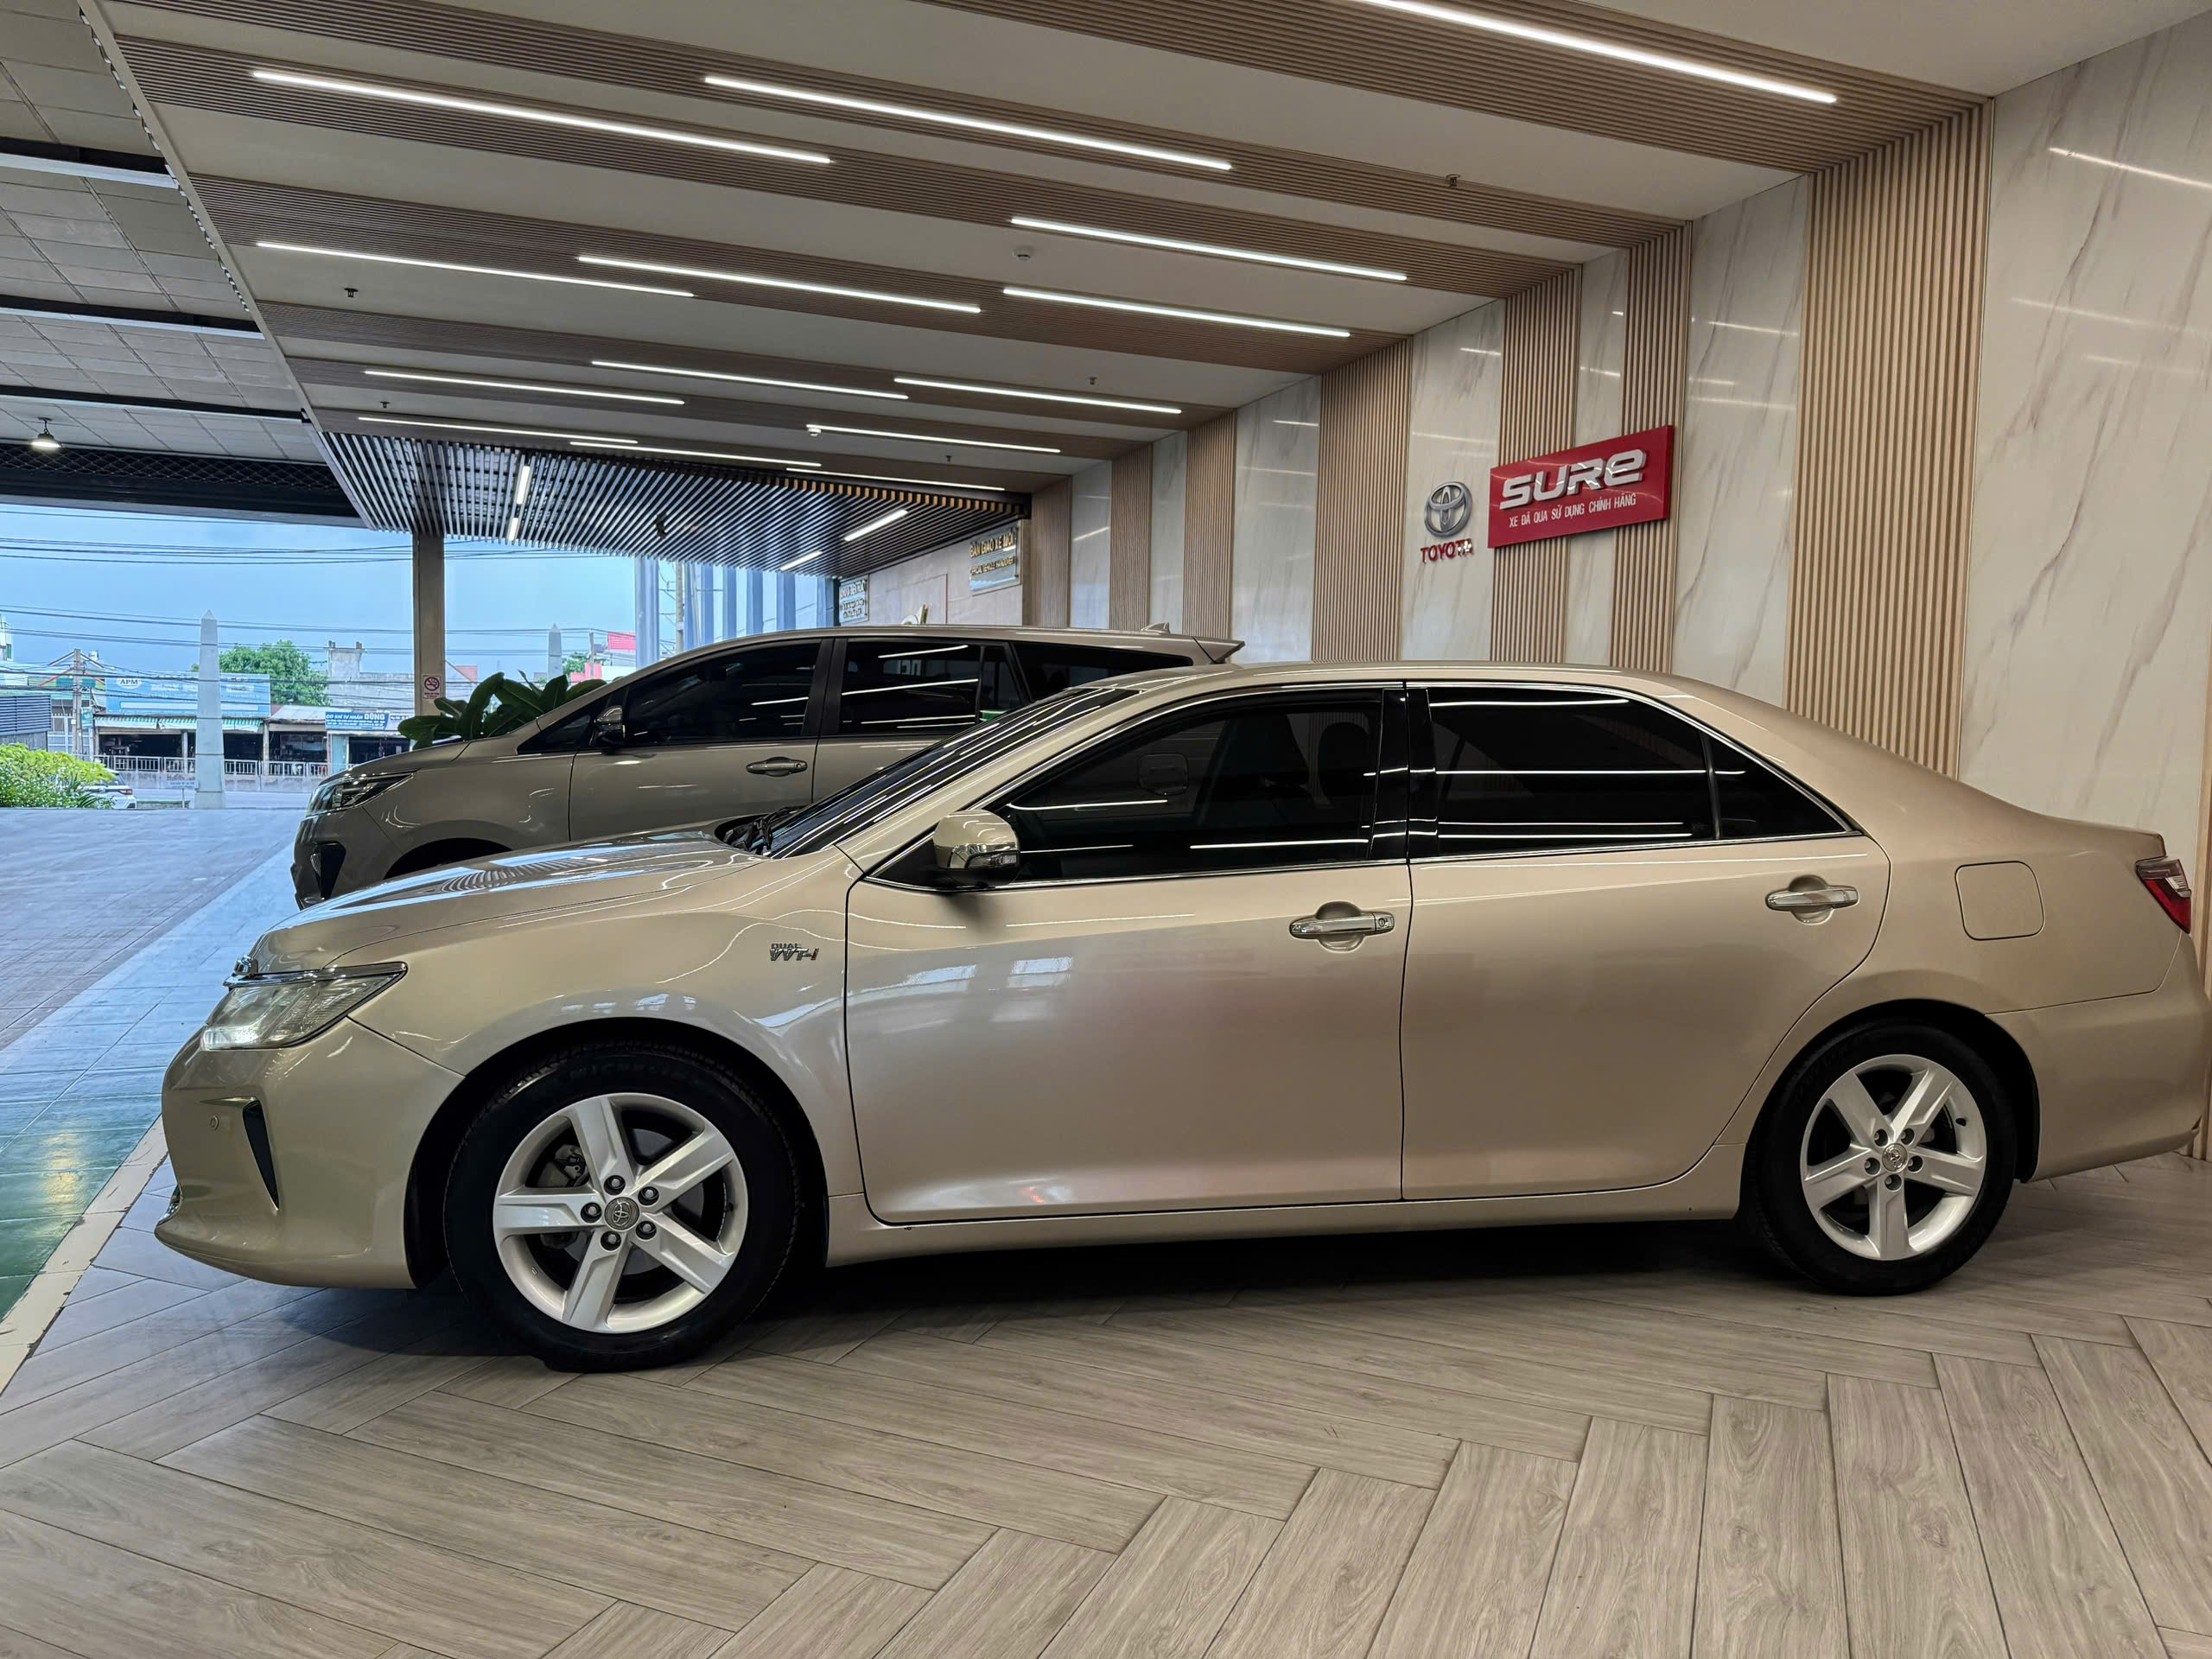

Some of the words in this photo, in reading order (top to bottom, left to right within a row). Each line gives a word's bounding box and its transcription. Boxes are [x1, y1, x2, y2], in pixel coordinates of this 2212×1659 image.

[1510, 516, 1518, 528] XE
[1534, 511, 1548, 524] QUA
[1565, 504, 1585, 518] DỤNG
[1589, 497, 1611, 513] CHÍNH
[1421, 538, 1474, 563] TOYOTA
